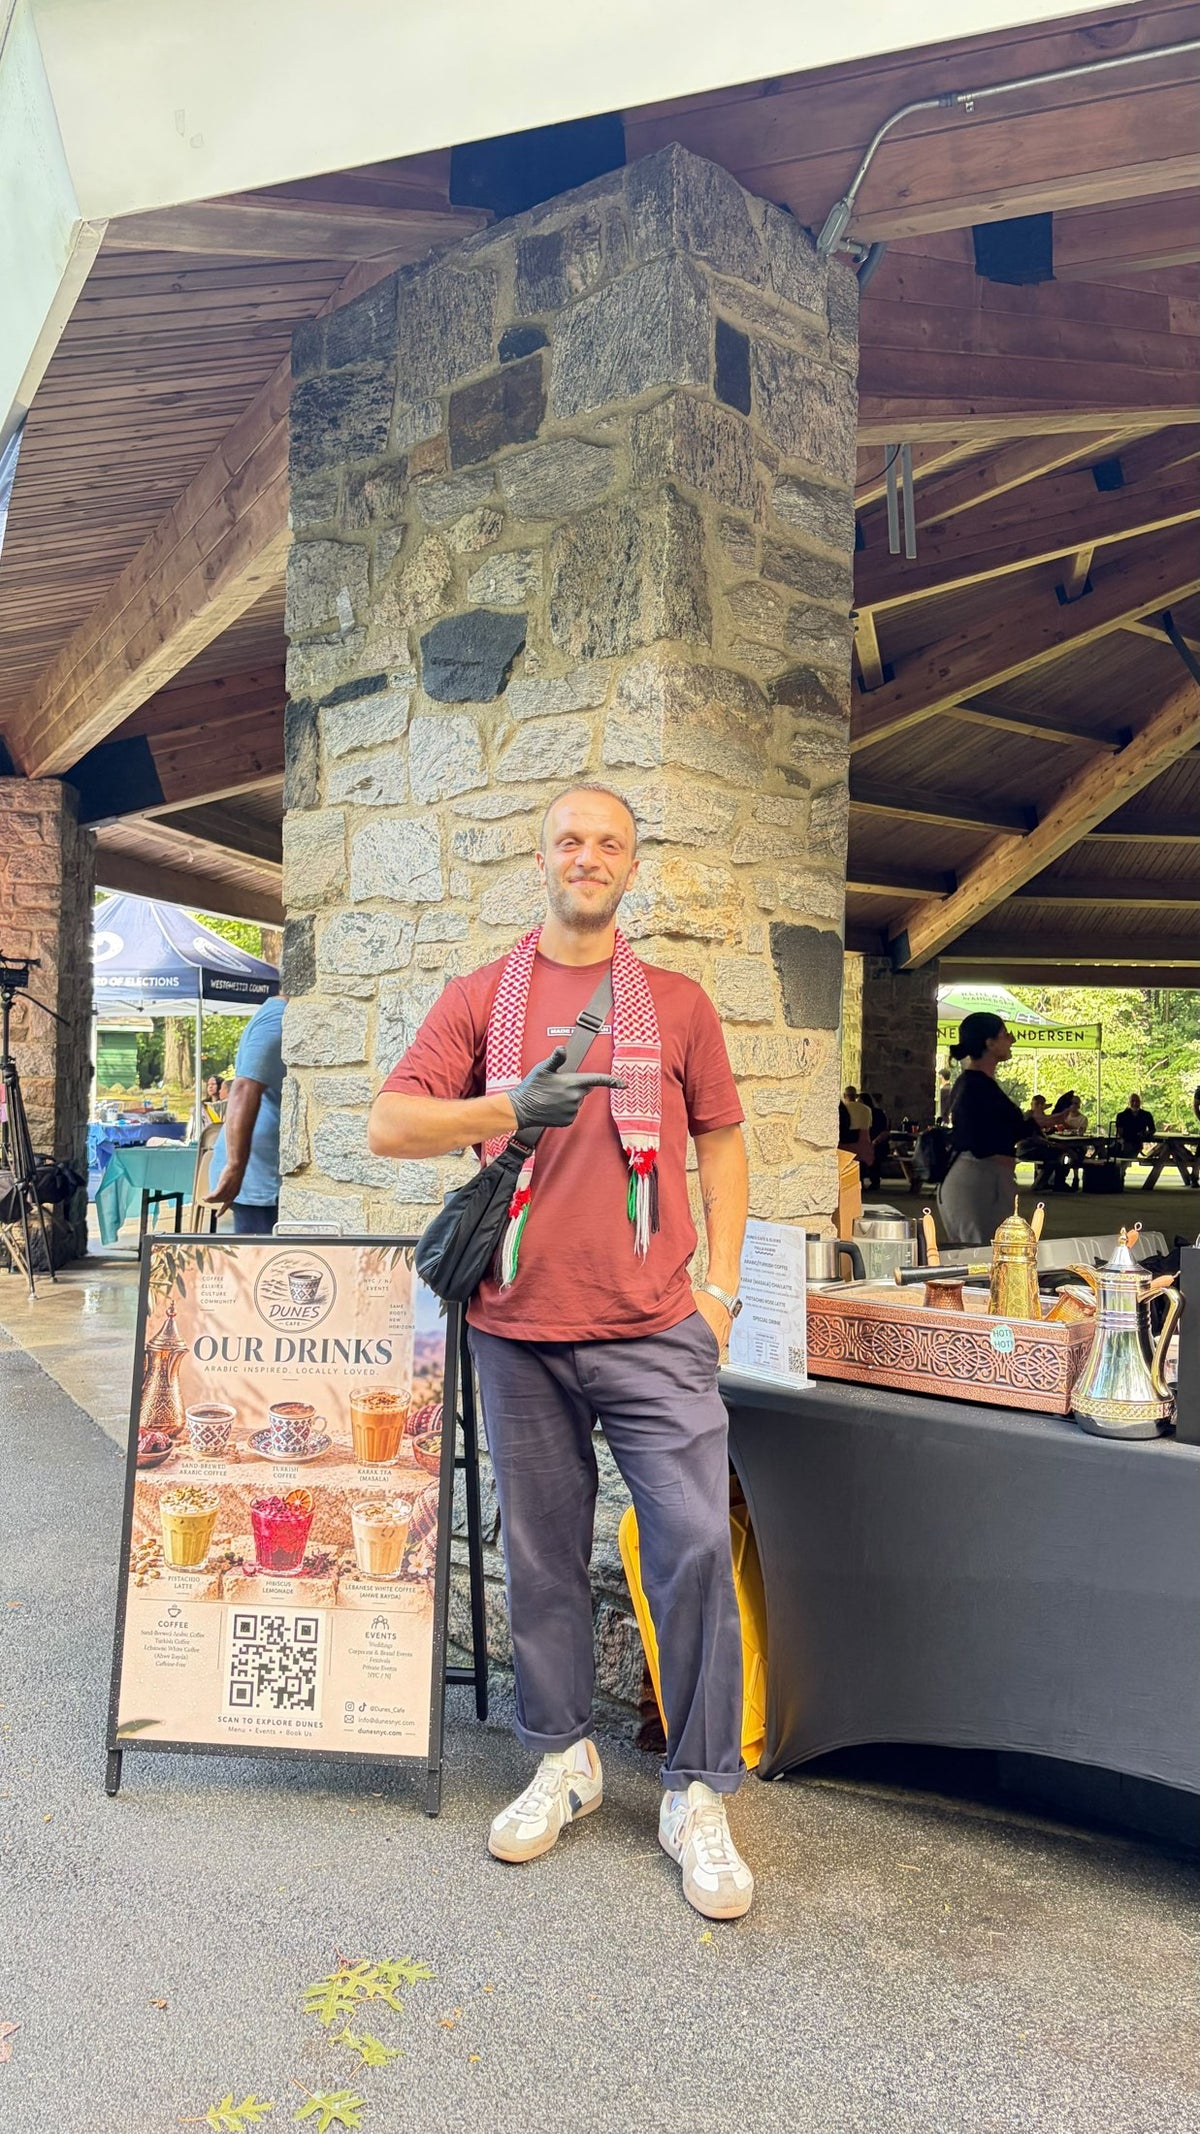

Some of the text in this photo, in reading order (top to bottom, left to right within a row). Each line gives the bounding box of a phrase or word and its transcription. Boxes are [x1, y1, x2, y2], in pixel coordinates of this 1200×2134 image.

[124, 976, 180, 987] ELECTIONS
[210, 979, 270, 994] WESTCHESTER COUNTY
[269, 1304, 320, 1318] DUNES
[193, 1335, 393, 1365] OUR DRINKS
[244, 1366, 291, 1374] INSPIRED.
[344, 1368, 379, 1376] LOVED.
[365, 1632, 397, 1640] EVENTS
[369, 1641, 393, 1649] Weddings
[256, 1718, 293, 1727] EXPLORE
[296, 1720, 324, 1728] DUNES
[255, 1727, 276, 1735] Events
[357, 1728, 402, 1736] dunesnyc.com
